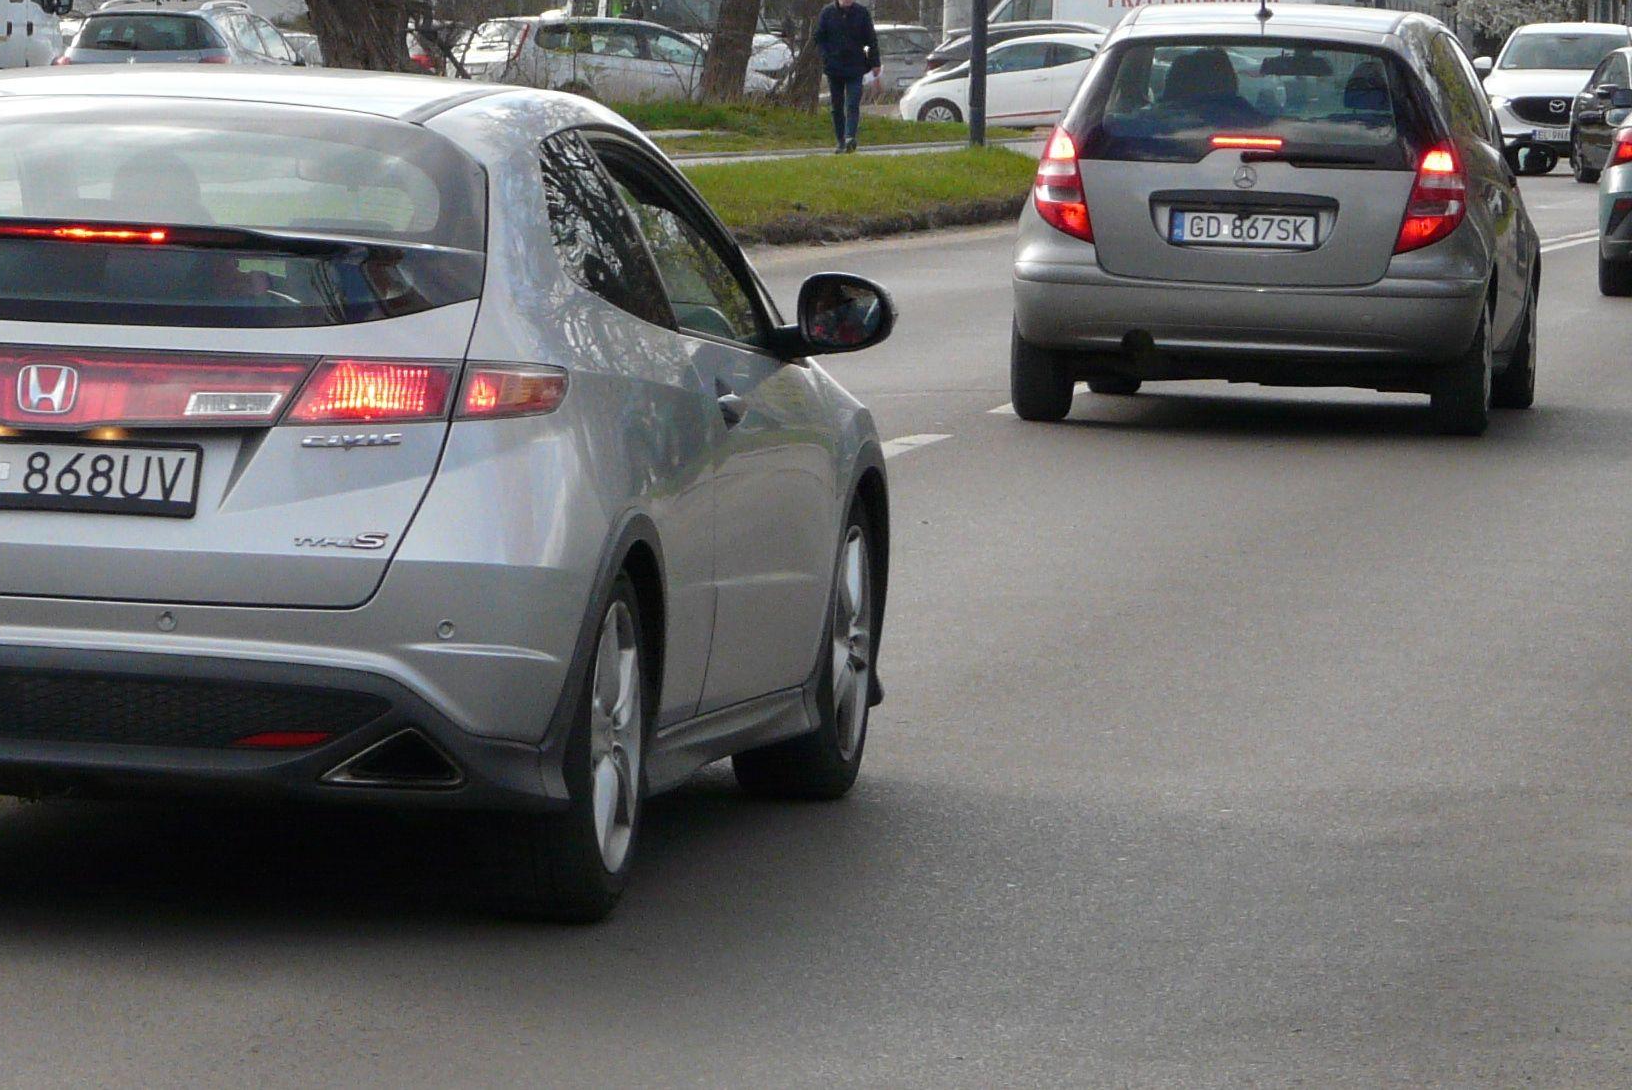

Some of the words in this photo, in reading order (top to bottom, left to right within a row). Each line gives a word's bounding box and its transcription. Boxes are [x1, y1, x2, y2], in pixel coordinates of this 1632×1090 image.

[1190, 215, 1221, 239] GD
[1231, 216, 1308, 242] 867SK
[301, 433, 402, 450] CIVIC
[22, 451, 186, 502] 868UV
